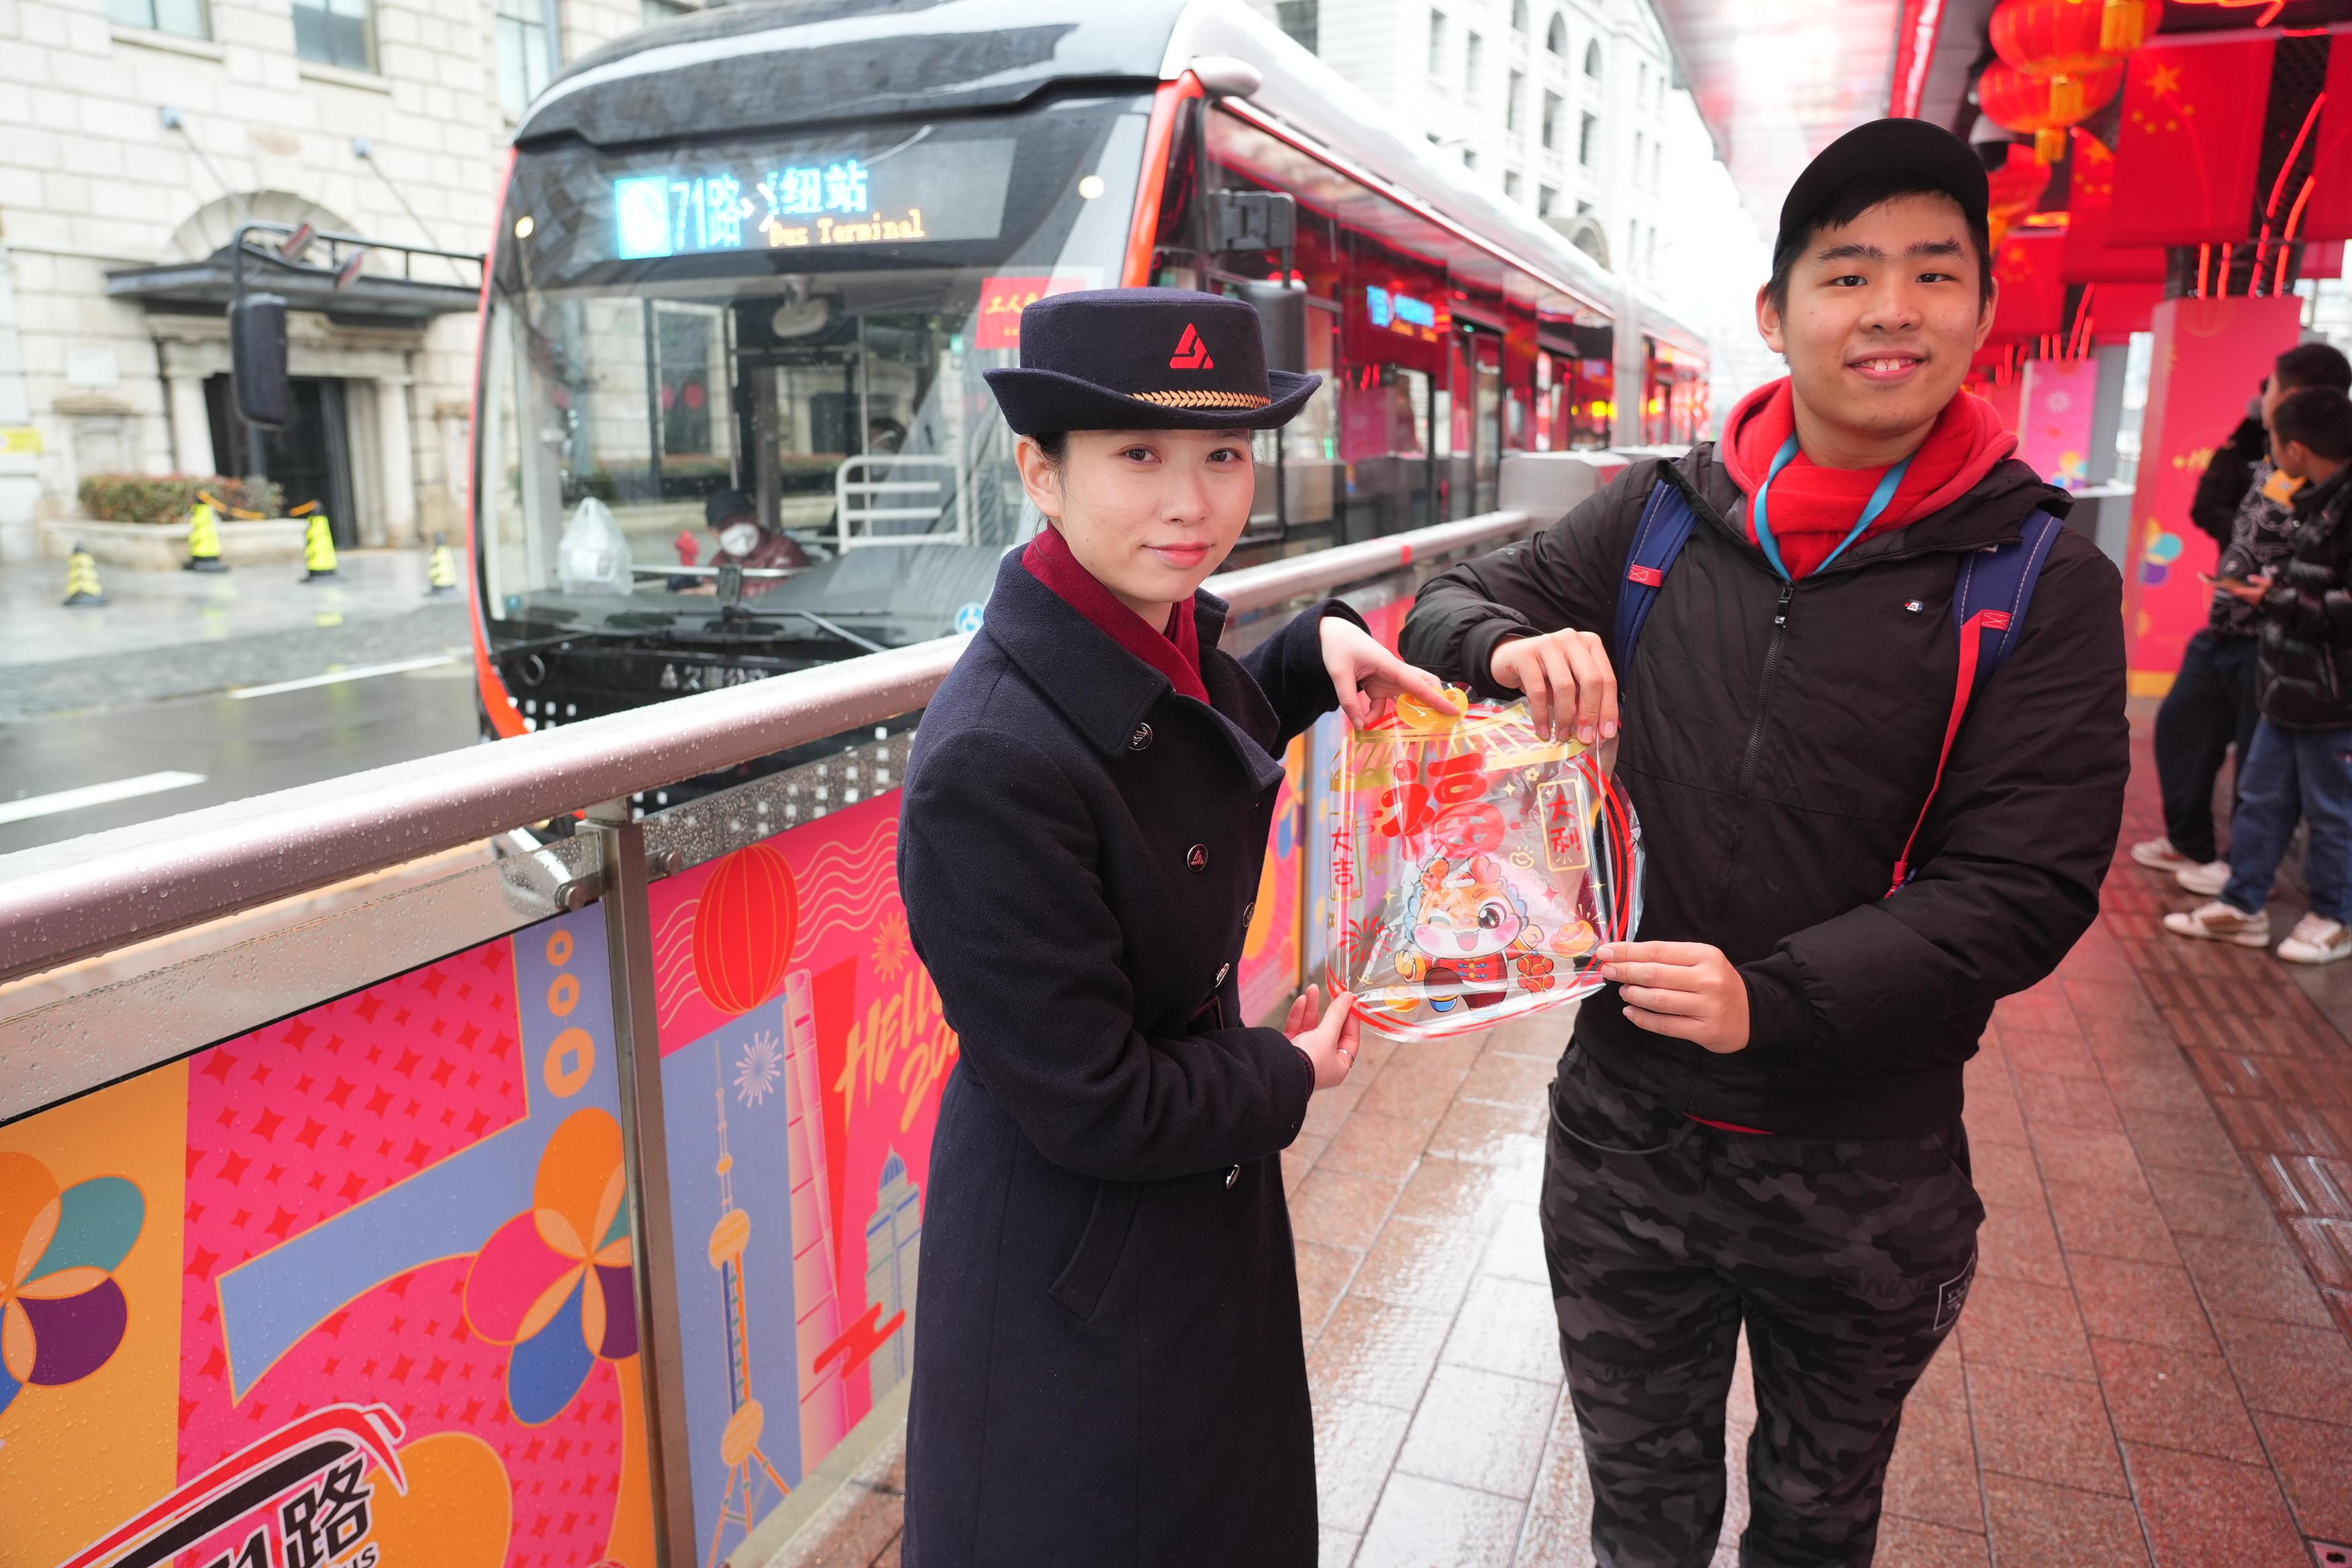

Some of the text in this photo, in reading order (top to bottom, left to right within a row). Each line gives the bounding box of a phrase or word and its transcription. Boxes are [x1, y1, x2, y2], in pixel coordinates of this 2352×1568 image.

[669, 159, 869, 250] 71路 纽站
[817, 209, 925, 244] Terminal
[1381, 752, 1506, 862] 福
[1546, 794, 1581, 854] 大利
[1331, 826, 1354, 886] 大吉
